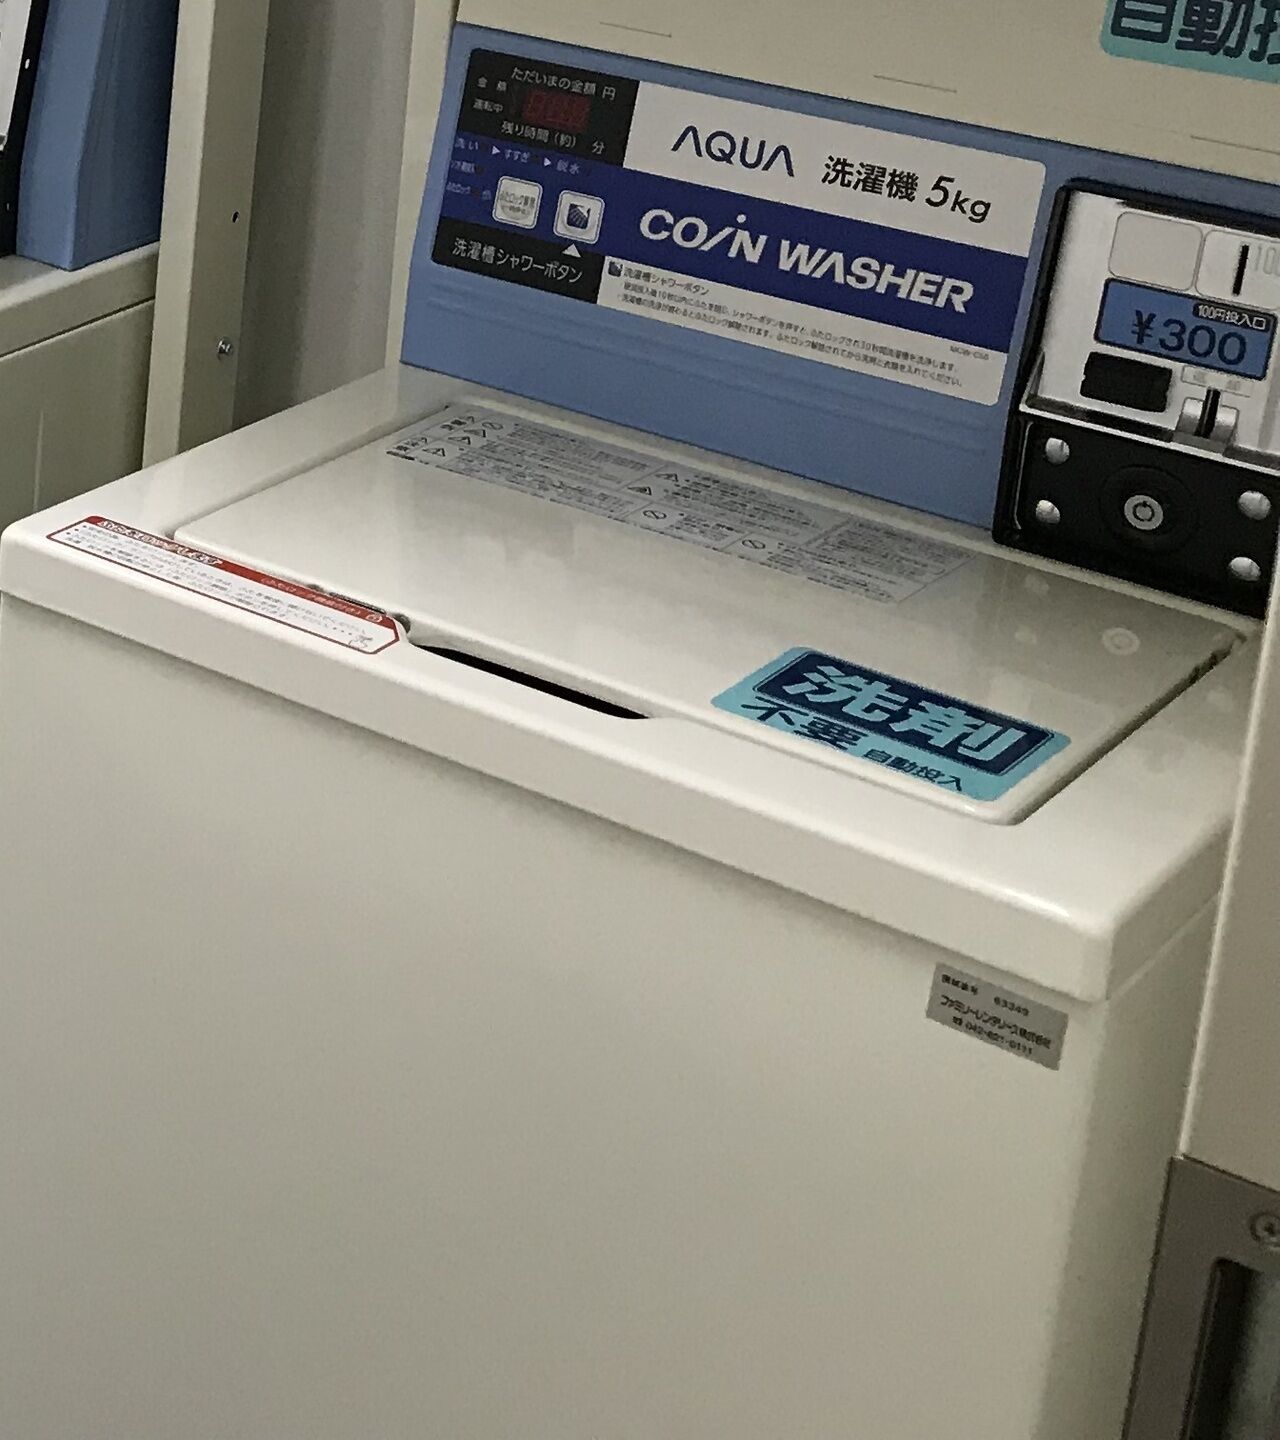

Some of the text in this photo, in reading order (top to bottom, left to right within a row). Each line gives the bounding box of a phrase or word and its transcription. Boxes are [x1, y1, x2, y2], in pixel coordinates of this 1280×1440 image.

[510, 67, 617, 101] ただいまの金額 円
[500, 120, 606, 155] 残り時間（約） 分
[670, 124, 993, 224] AQUA 洗濯機 5kg
[451, 235, 584, 284] 洗濯槽シャワーボタン
[623, 266, 711, 296] 洗濯槽シャワーボタン
[777, 239, 976, 315] WASHER
[1131, 310, 1248, 367] ¥300
[1197, 304, 1267, 330] 100円投入口
[781, 664, 1027, 763] 洗剤
[740, 695, 964, 792] 不要 自動投入
